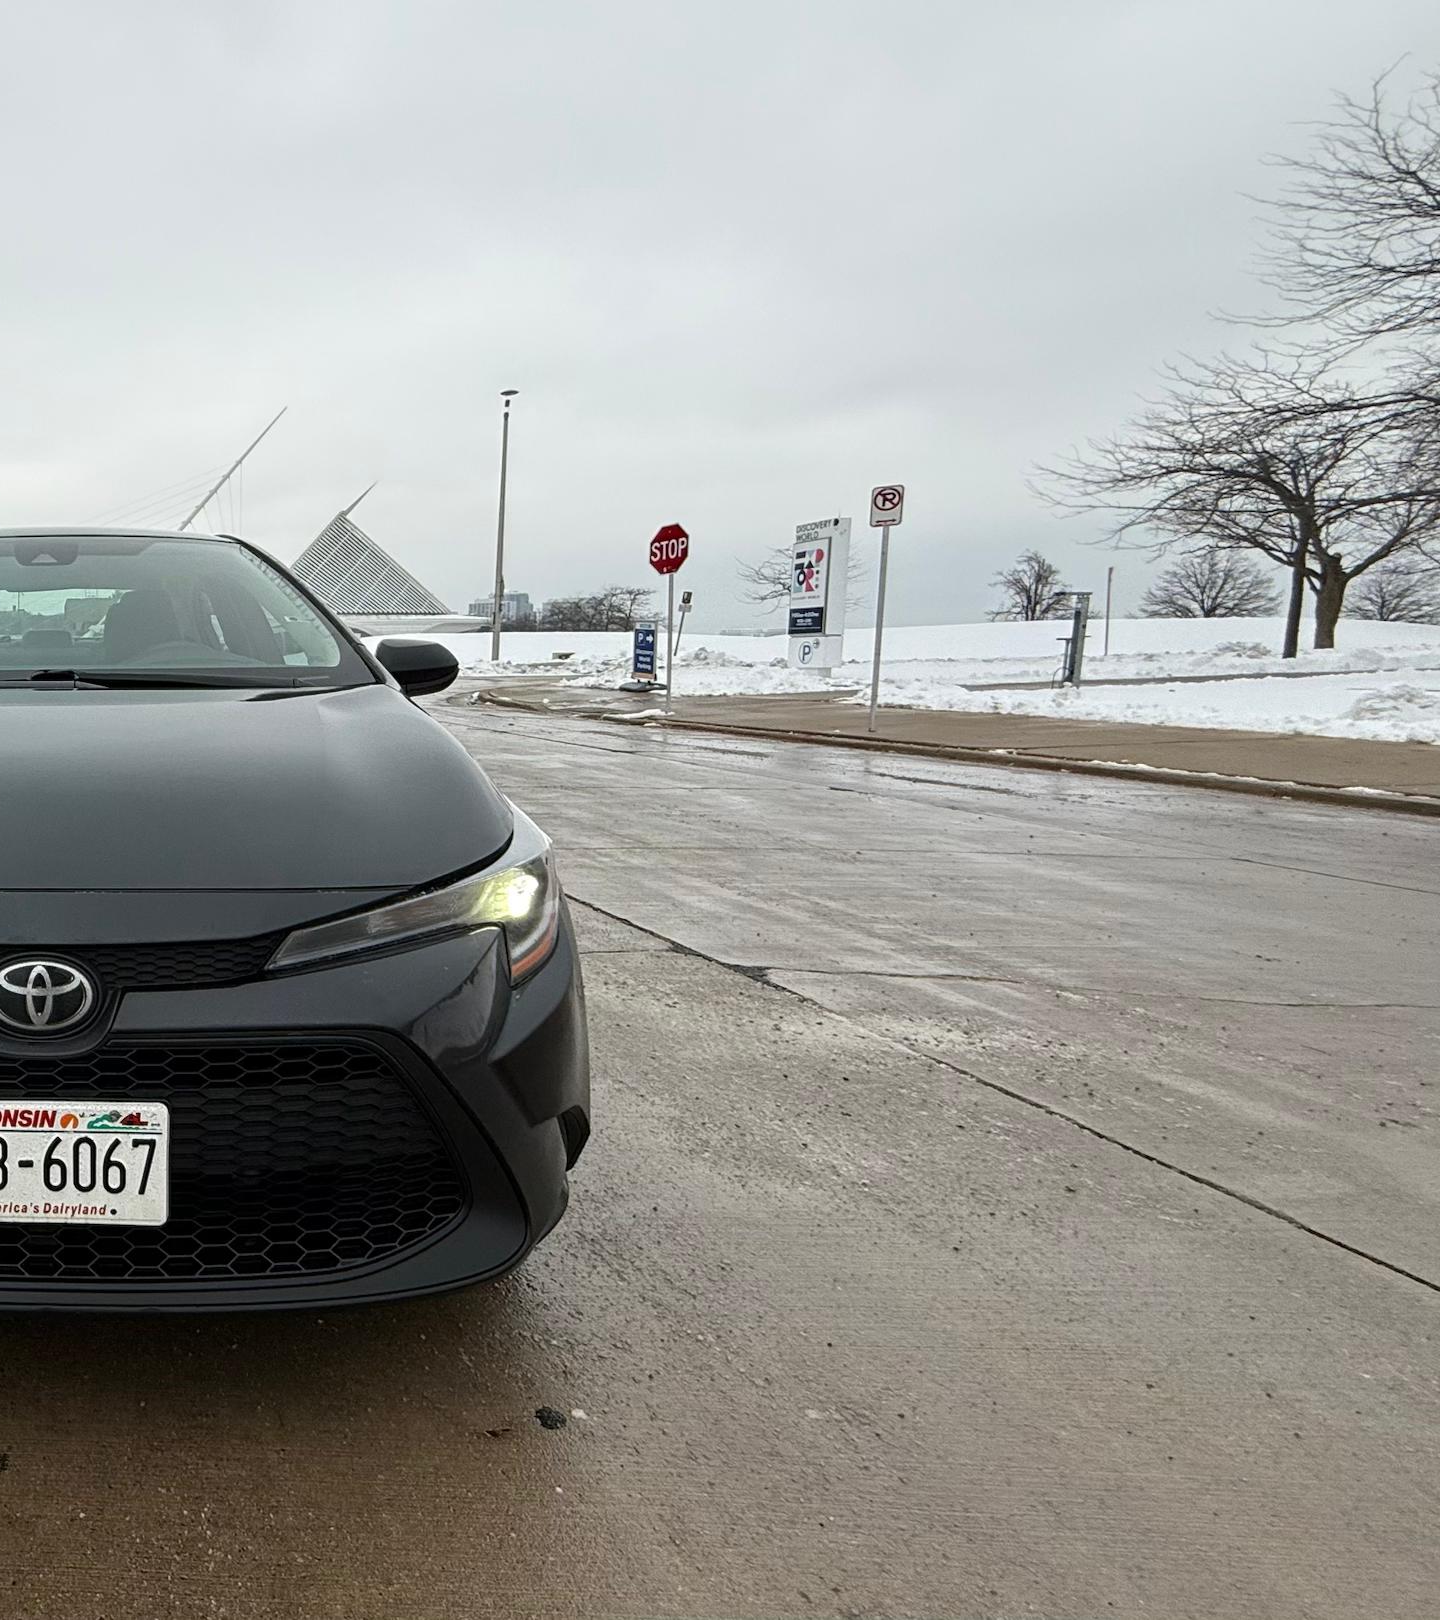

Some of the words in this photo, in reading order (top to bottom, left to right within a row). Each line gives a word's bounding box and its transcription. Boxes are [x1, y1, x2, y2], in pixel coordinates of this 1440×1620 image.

[796, 519, 832, 534] DISCOVERY
[796, 531, 819, 542] WORLD
[651, 537, 687, 562] STOP
[638, 632, 644, 643] P
[802, 645, 811, 661] P
[43, 1203, 107, 1217] Dairyland
